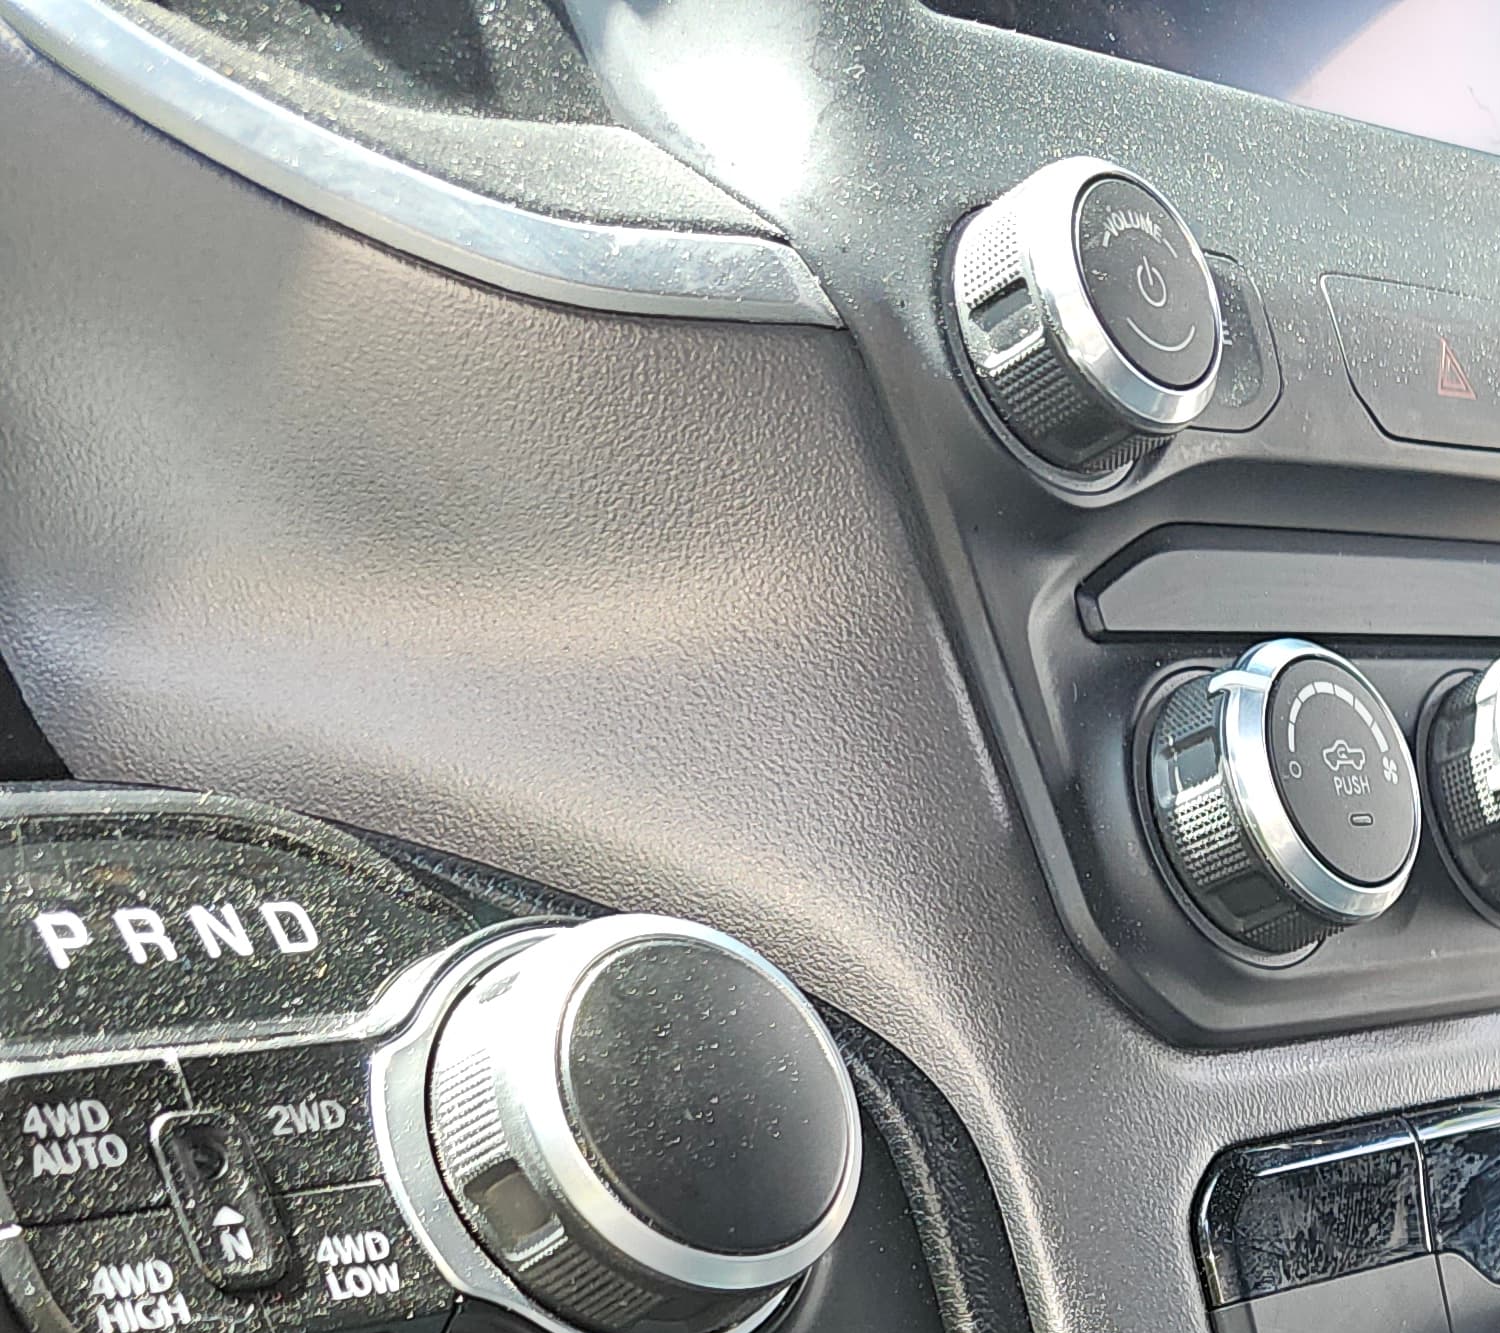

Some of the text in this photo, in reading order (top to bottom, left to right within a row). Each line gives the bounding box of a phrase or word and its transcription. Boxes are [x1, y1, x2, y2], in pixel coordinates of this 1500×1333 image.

[1103, 209, 1163, 244] VOLUME
[1333, 775, 1371, 795] PUSH
[23, 1099, 110, 1139] 4WD
[267, 1099, 347, 1136] 2WD
[31, 1133, 128, 1178] AUTO
[220, 1227, 254, 1261] N
[316, 1230, 391, 1267] 4WD
[92, 1258, 174, 1299] 4WD
[325, 1261, 401, 1301] LOW
